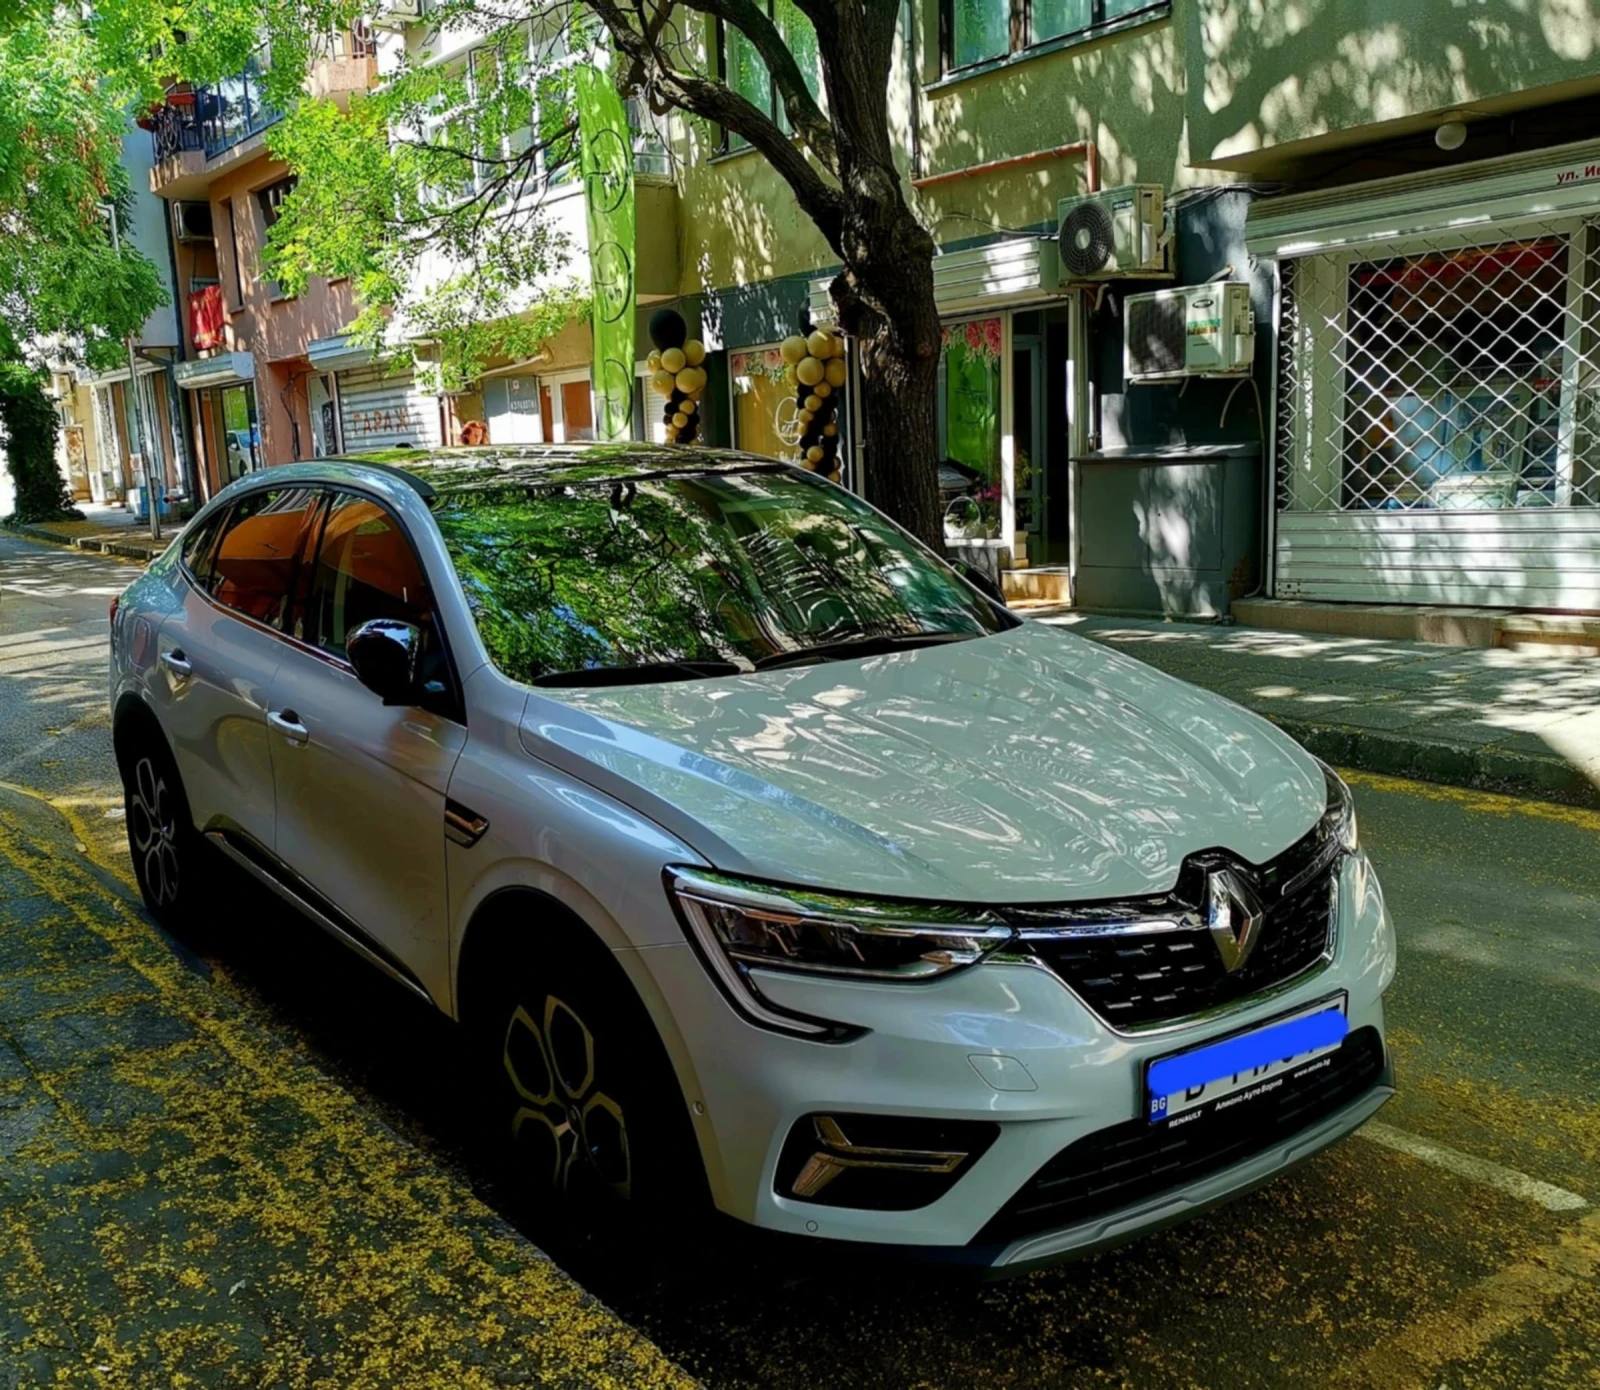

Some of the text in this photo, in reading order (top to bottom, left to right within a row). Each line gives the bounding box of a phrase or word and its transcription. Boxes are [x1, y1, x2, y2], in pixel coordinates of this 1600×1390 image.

[1557, 171, 1579, 185] ул.
[1151, 1096, 1166, 1113] BG
[1168, 1110, 1202, 1128] RENAULT
